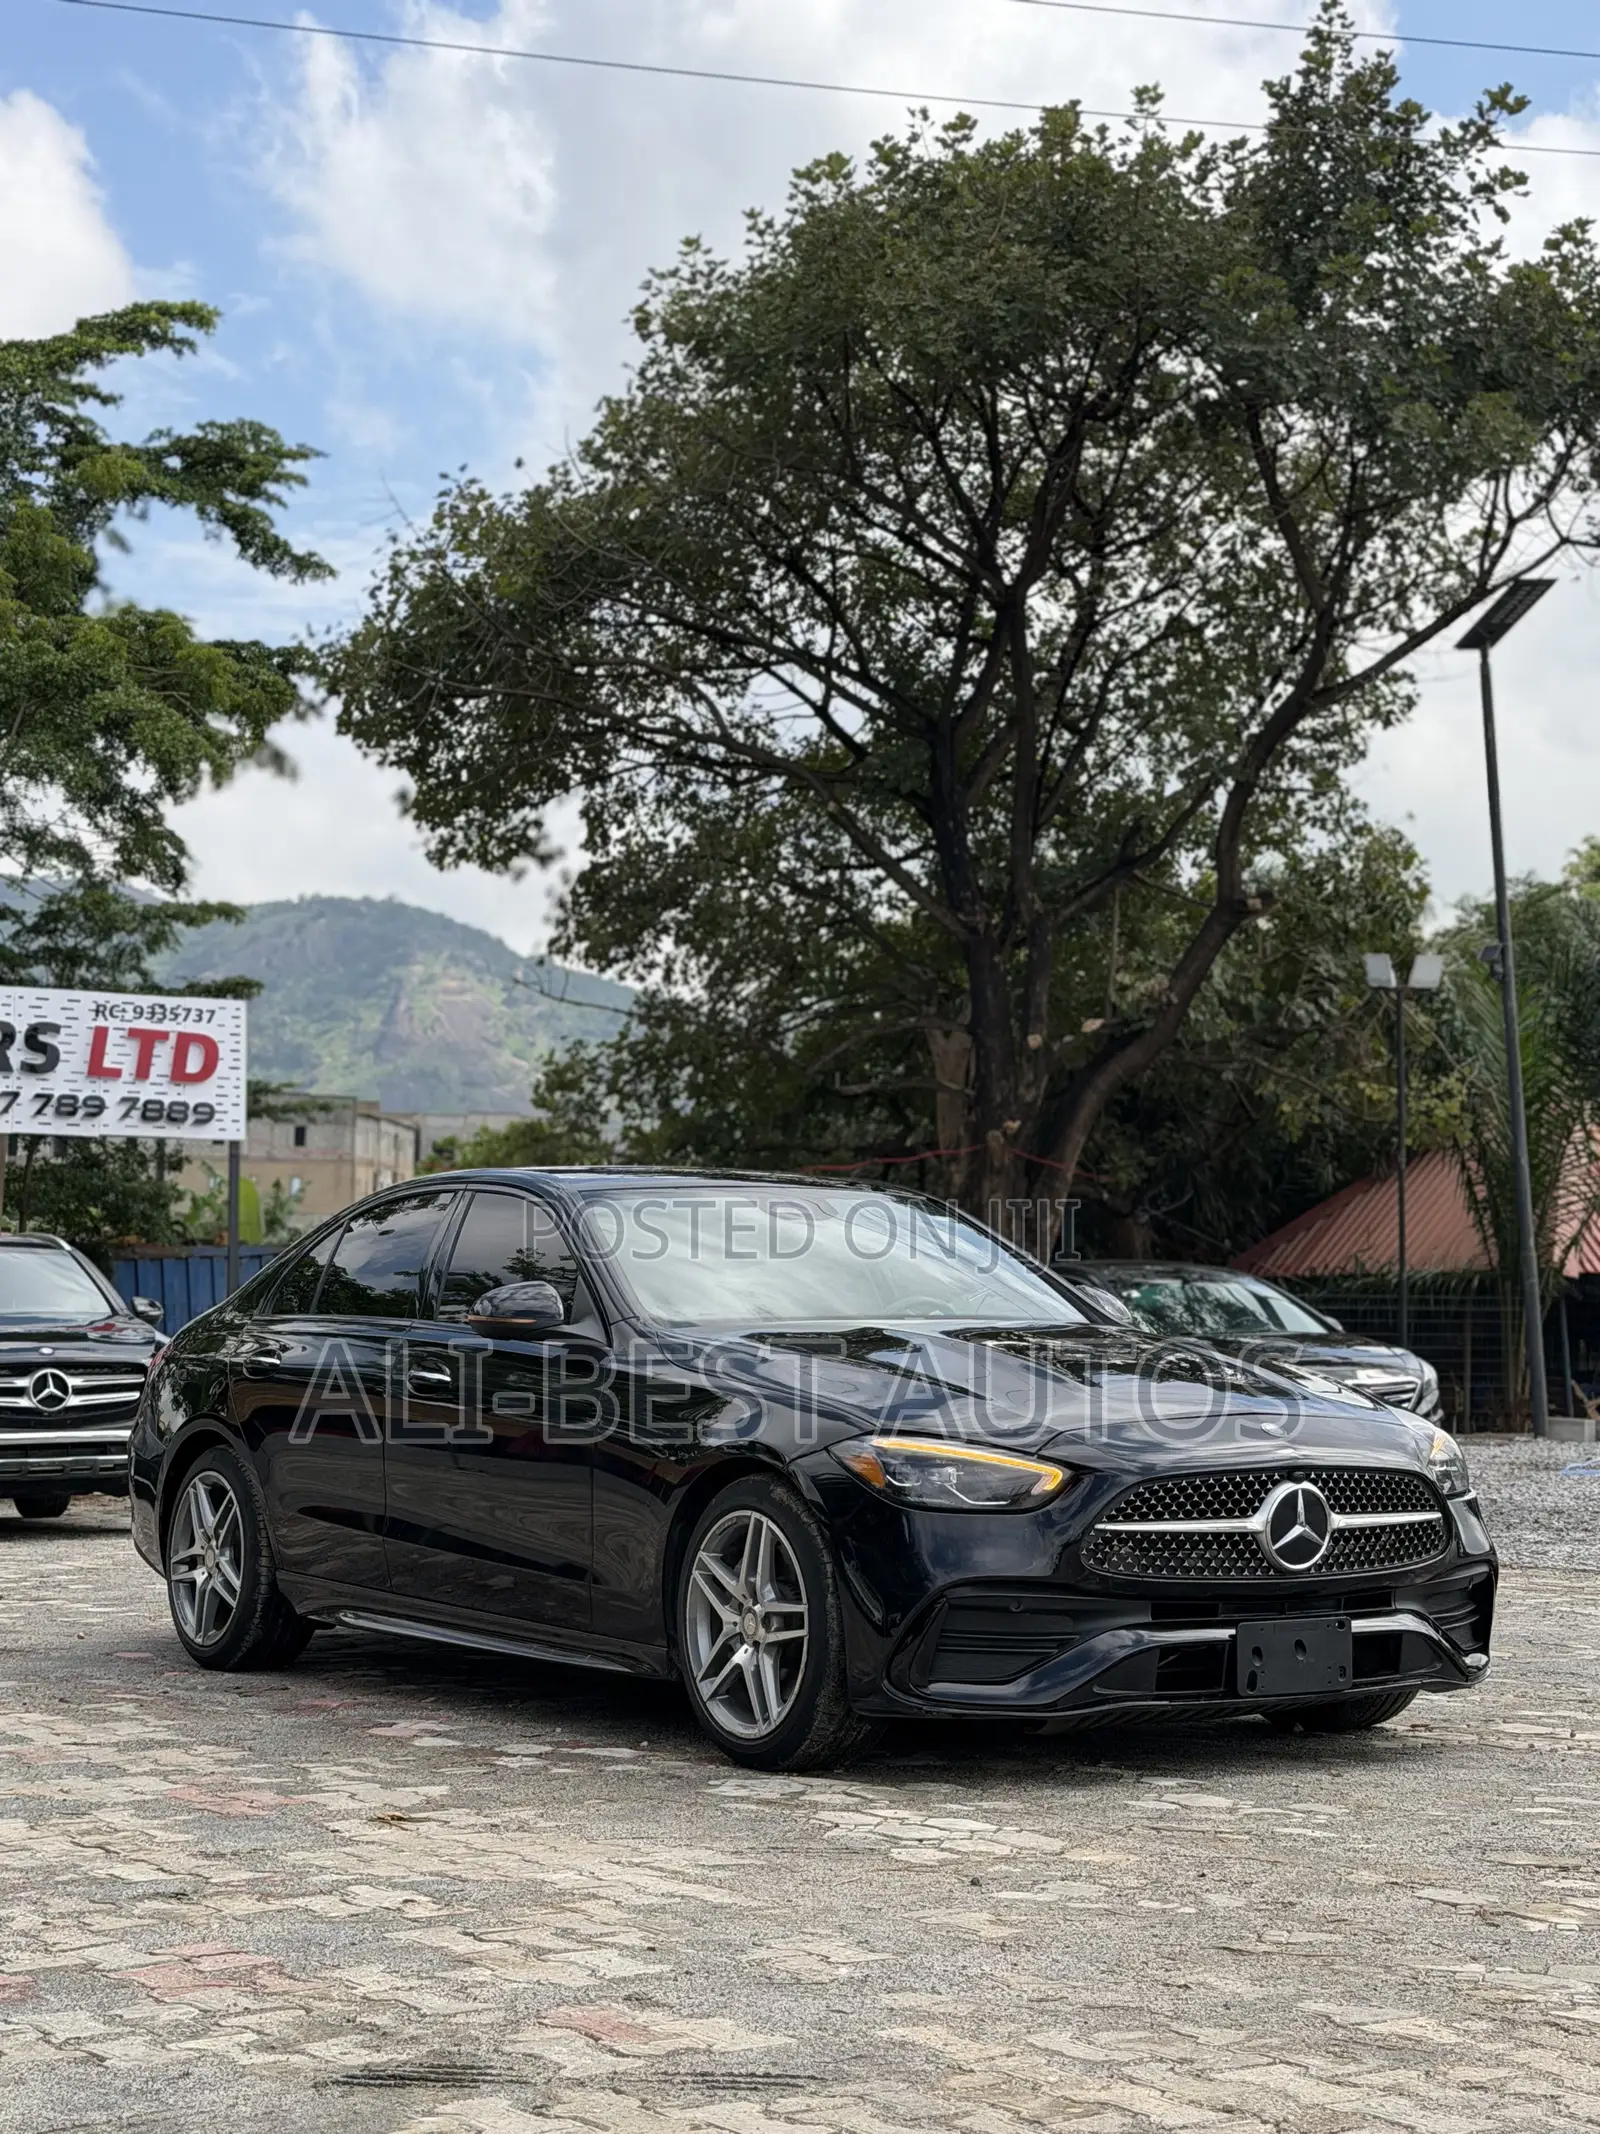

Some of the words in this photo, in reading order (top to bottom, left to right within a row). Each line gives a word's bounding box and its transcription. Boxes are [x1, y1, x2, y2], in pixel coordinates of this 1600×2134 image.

[87, 1025, 219, 1083] LTD
[31, 1092, 106, 1118] 789
[118, 1096, 216, 1125] 7889
